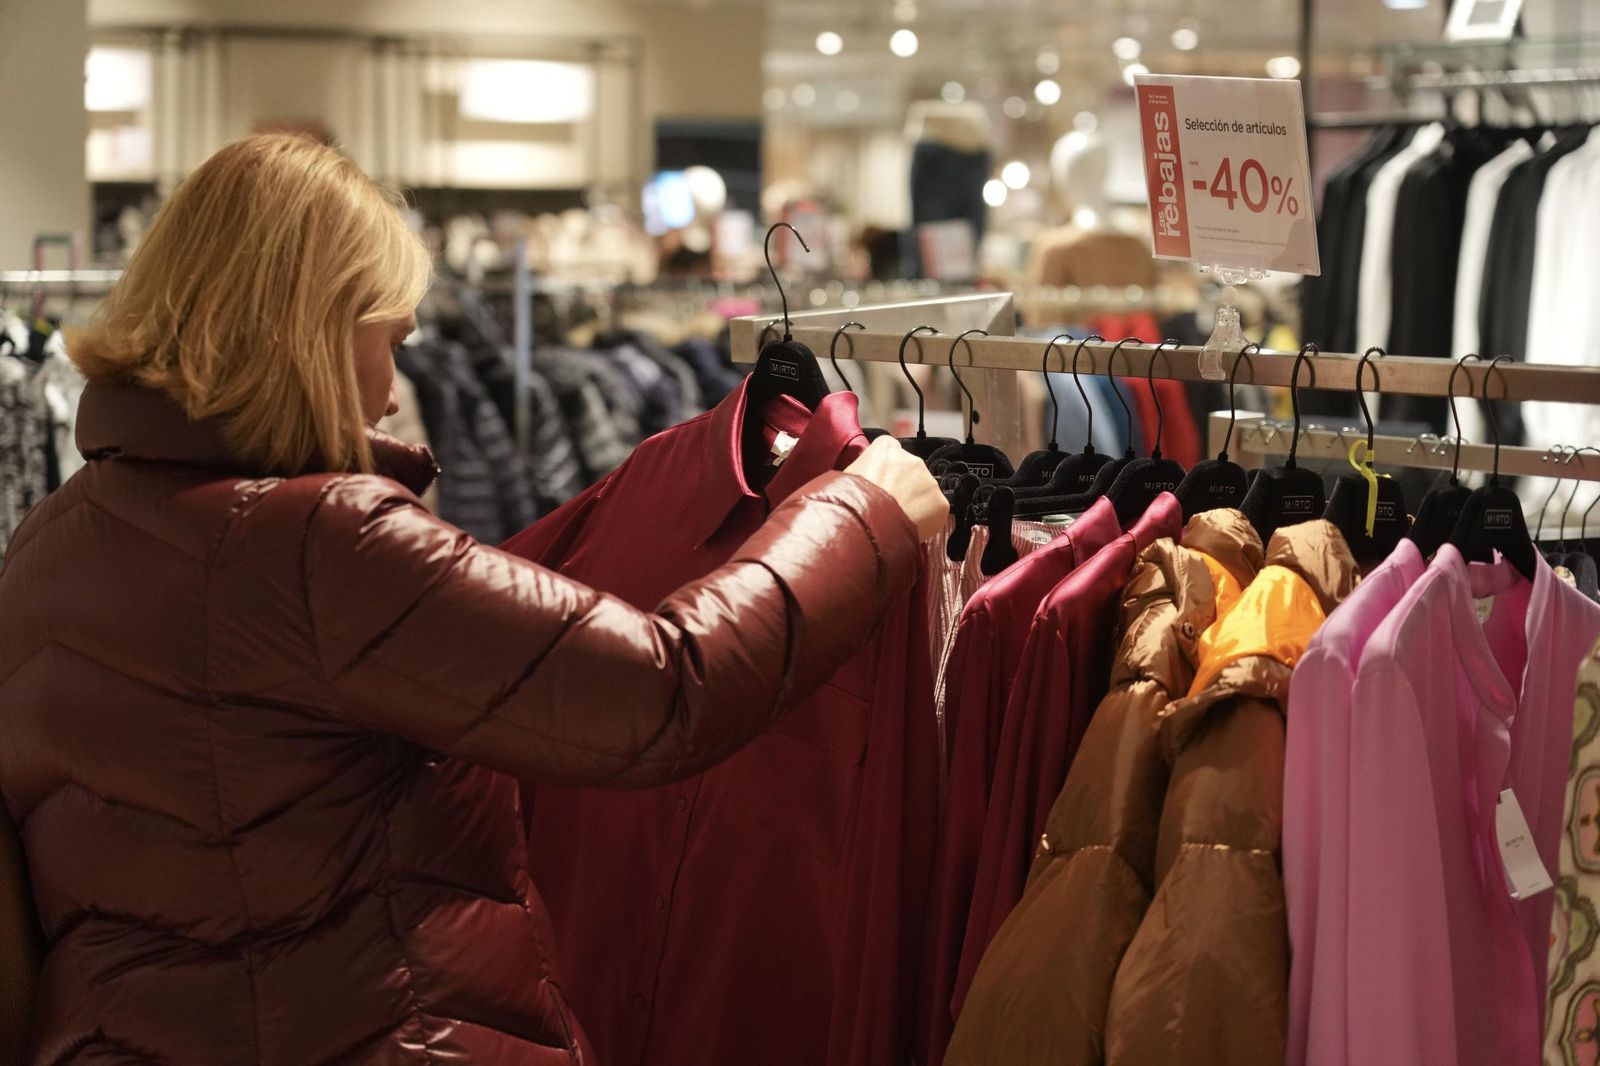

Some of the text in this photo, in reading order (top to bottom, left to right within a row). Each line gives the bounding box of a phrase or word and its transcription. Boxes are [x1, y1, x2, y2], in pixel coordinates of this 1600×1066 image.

[1185, 117, 1287, 136] Selección de artículos
[1153, 111, 1181, 237] rebajas
[1192, 157, 1299, 216] -40%
[1158, 211, 1167, 236] Las
[772, 363, 796, 376] MIRTO
[968, 467, 990, 476] RTO
[1079, 474, 1096, 483] MIR
[1144, 482, 1175, 490] MIRTO
[1209, 485, 1236, 495] MIRTO
[1284, 500, 1311, 510] MIRTO
[1378, 506, 1393, 517] RTO
[1486, 514, 1511, 525] MIRTO
